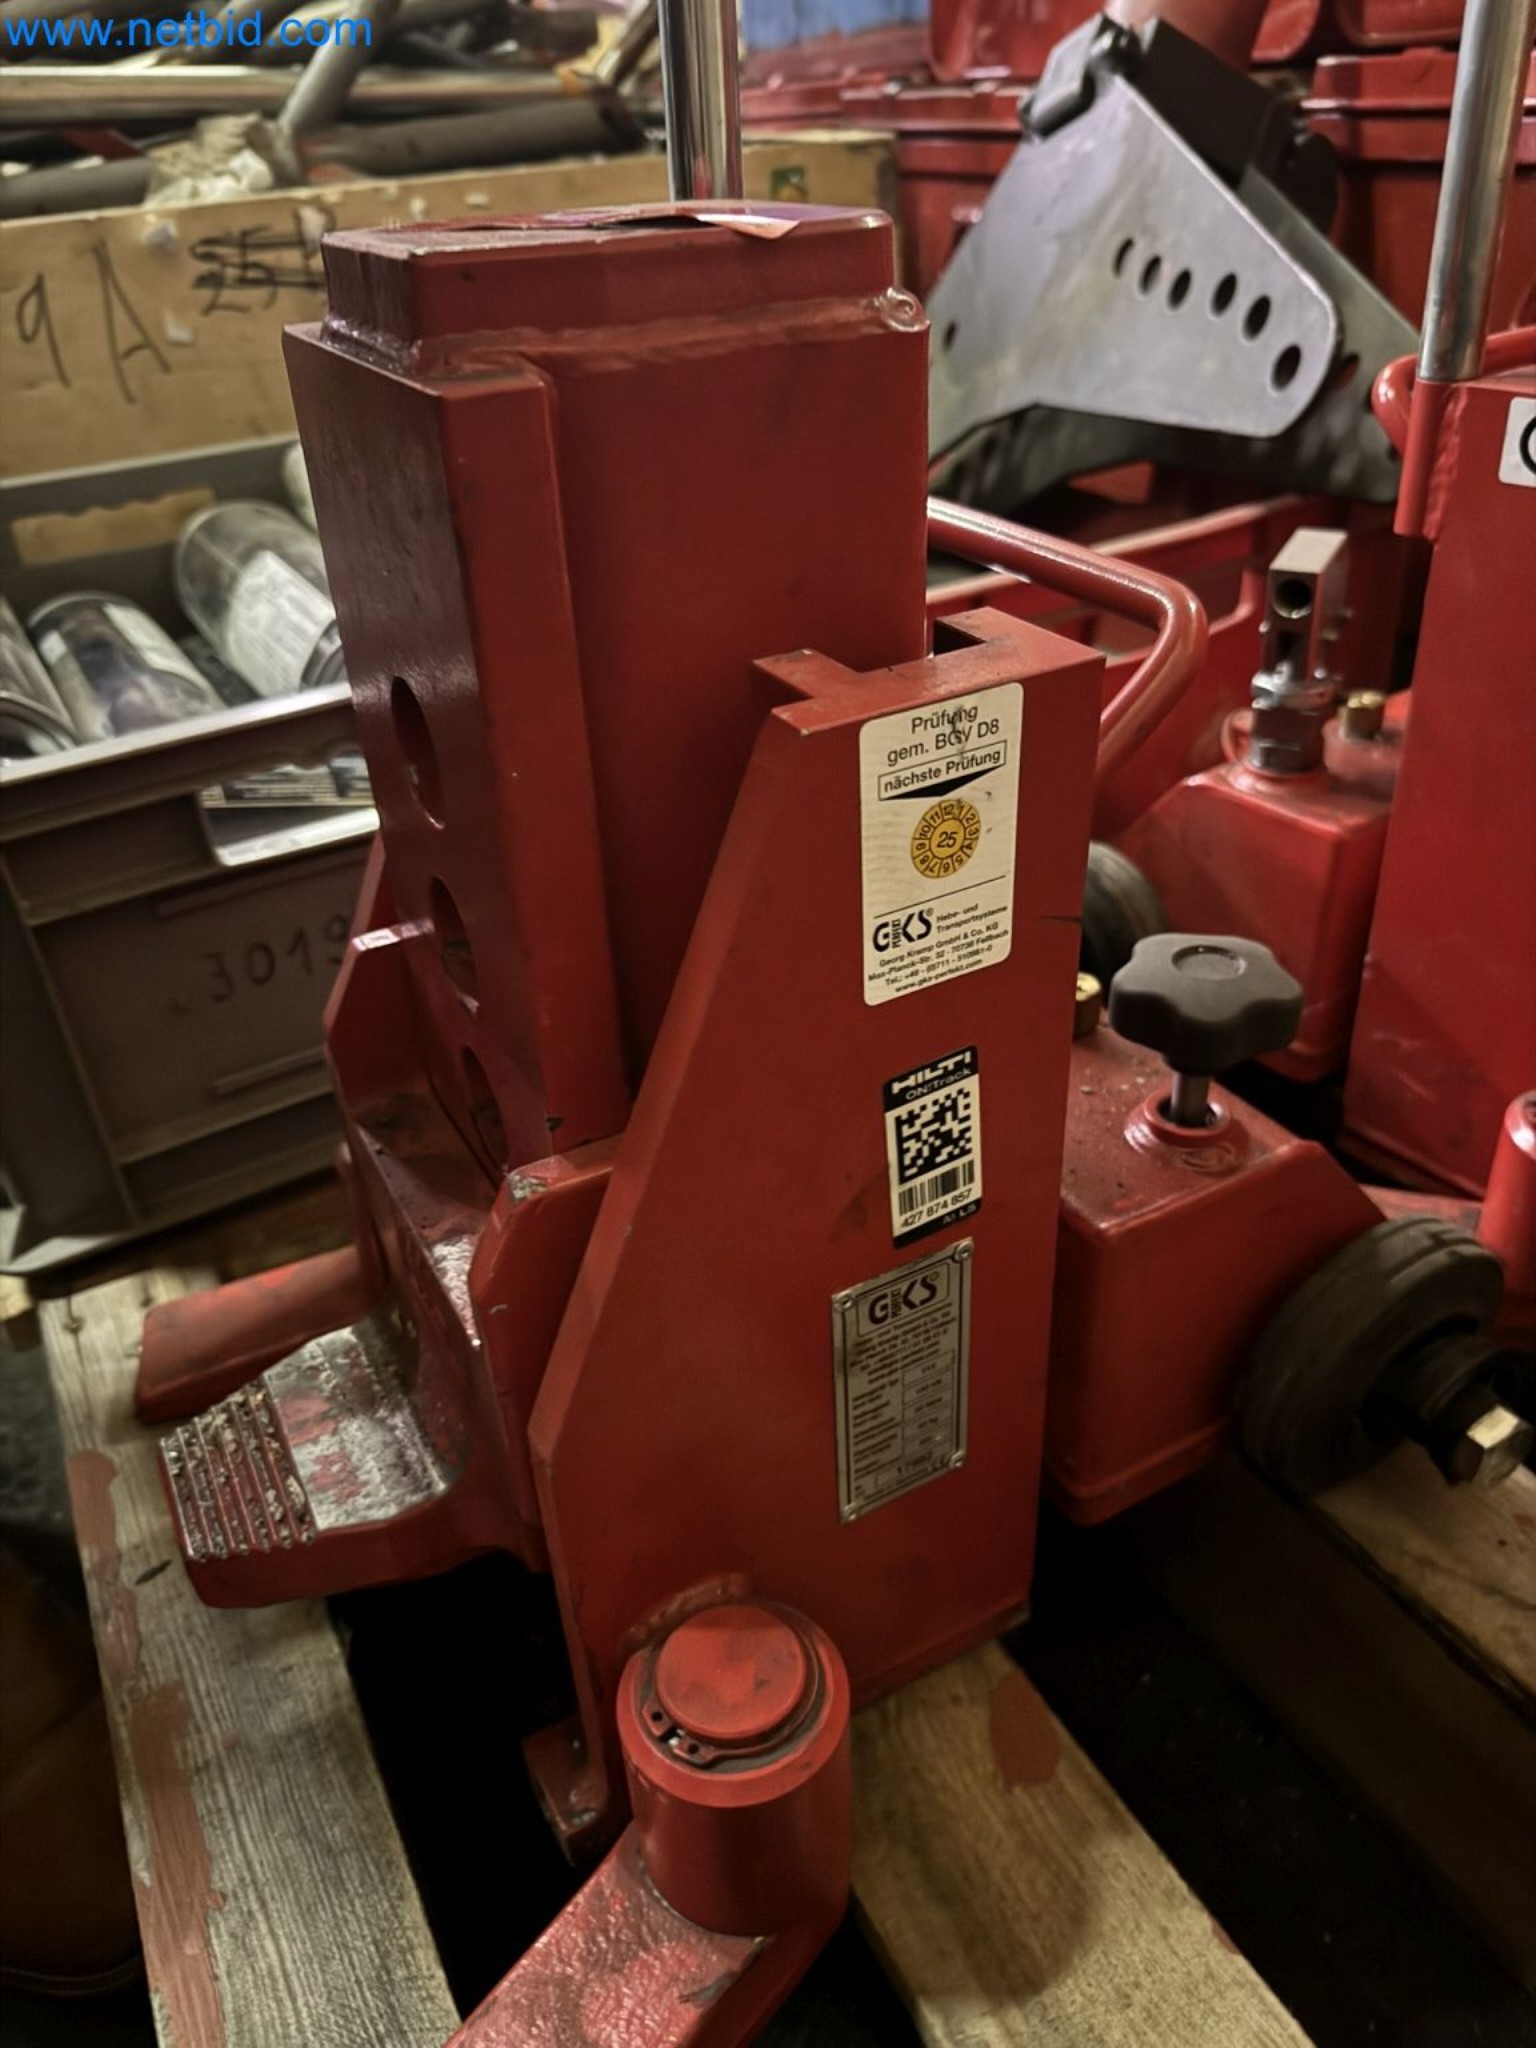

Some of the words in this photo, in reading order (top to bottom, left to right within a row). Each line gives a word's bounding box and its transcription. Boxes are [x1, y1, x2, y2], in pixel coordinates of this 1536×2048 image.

[93, 236, 171, 403] A
[911, 705, 978, 735] Prüfung
[887, 742, 929, 767] gem.
[977, 718, 999, 739] D8
[884, 767, 942, 793] nächste
[945, 750, 1001, 775] Prüfung
[936, 831, 958, 849] 25
[892, 1051, 971, 1095] HILTI
[901, 1210, 923, 1227] 427
